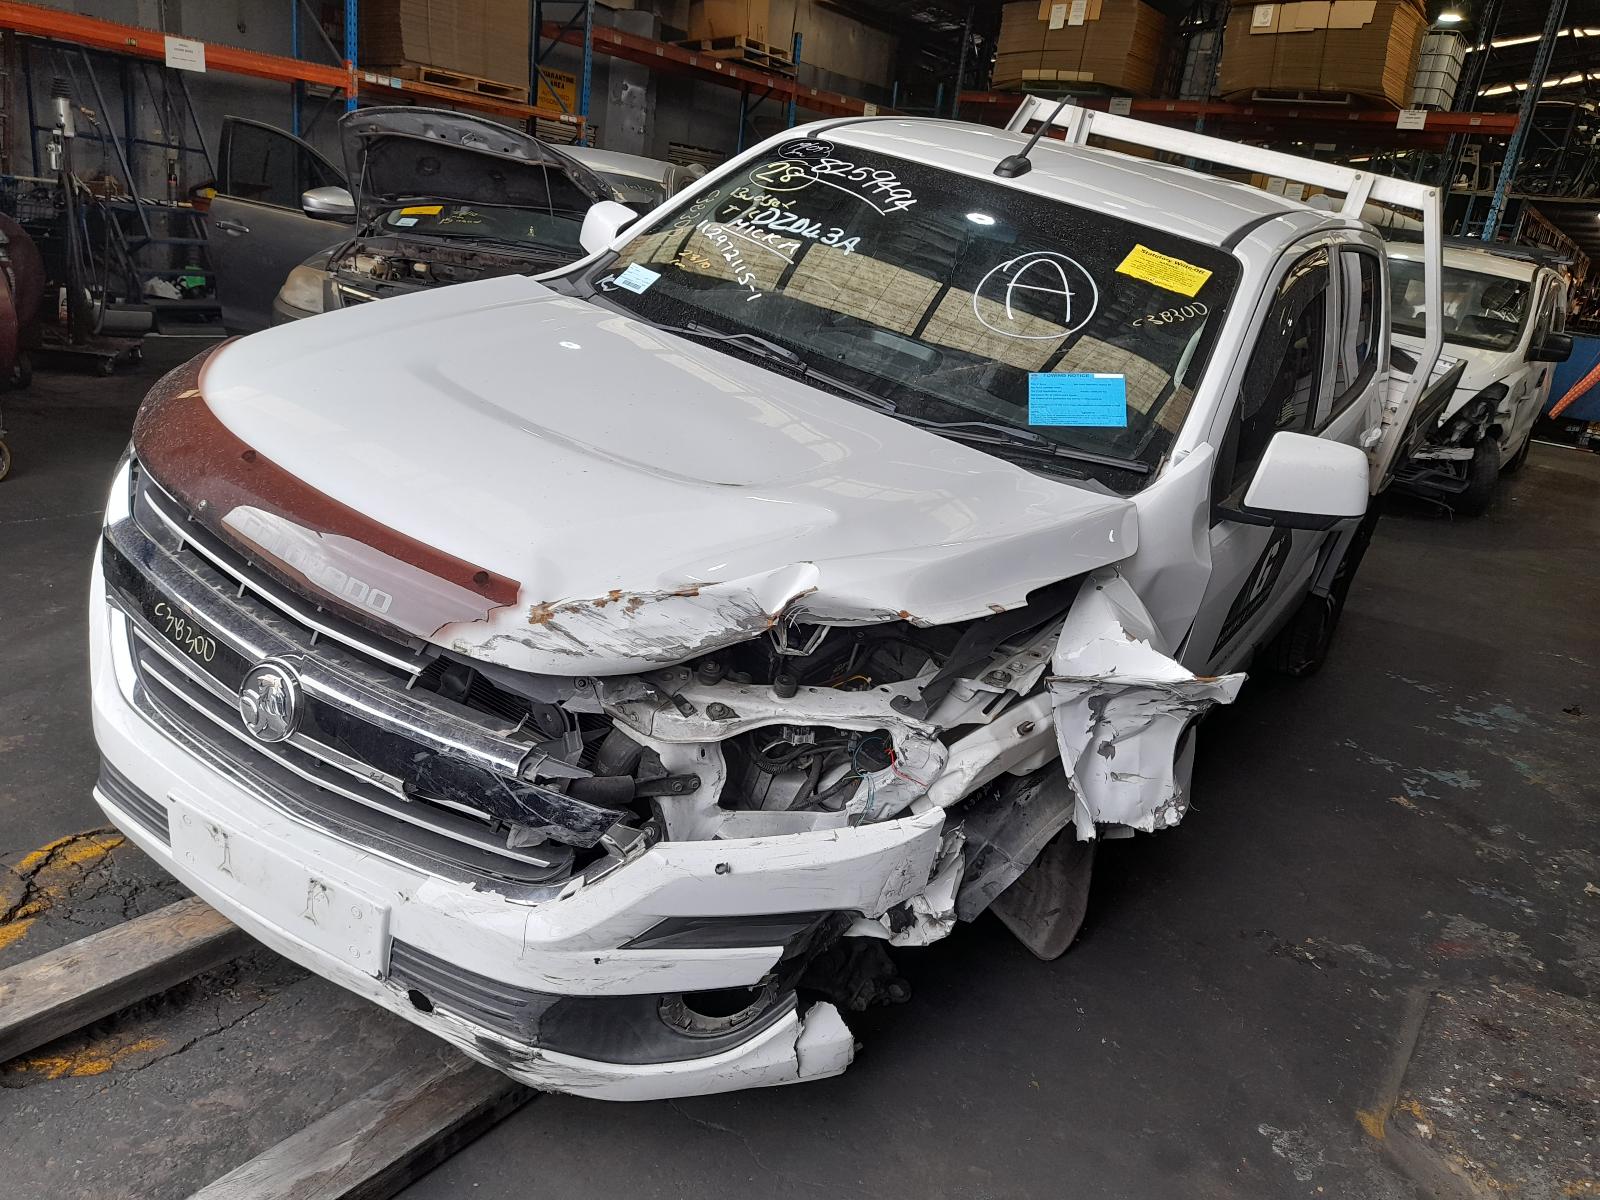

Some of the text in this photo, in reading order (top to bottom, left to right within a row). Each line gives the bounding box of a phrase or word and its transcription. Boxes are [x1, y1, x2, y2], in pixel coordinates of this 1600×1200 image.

[1141, 248, 1172, 263] Statutory
[1006, 258, 1076, 323] A
[154, 602, 217, 662] C38300
